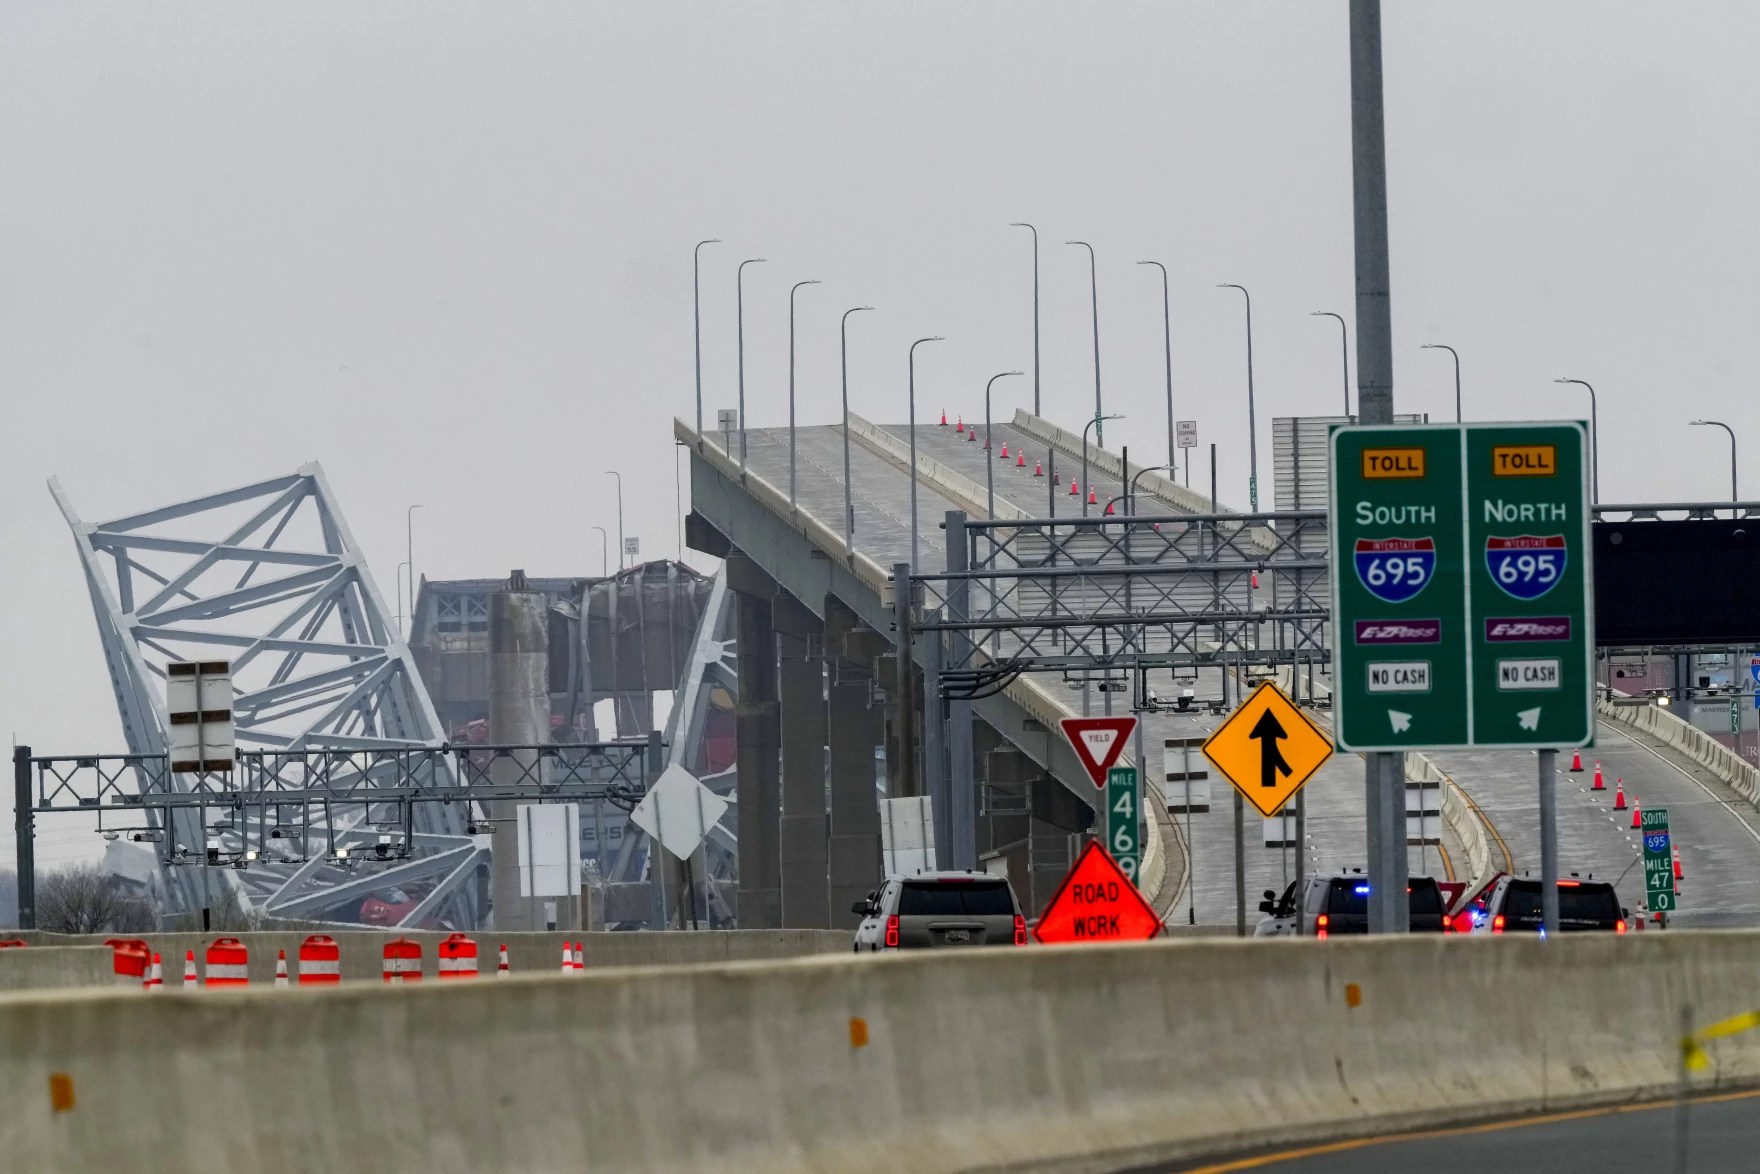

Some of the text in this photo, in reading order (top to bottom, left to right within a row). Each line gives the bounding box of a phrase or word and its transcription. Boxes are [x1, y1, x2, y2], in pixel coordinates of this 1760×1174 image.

[1369, 456, 1419, 471] TOLL
[1499, 453, 1549, 469] TOLL
[1372, 542, 1416, 551] INTERSTATE
[1503, 540, 1547, 549] INTERSTATE
[1367, 557, 1426, 586] 695
[1498, 554, 1557, 584] 695
[1372, 669, 1426, 685] NO CASH
[1502, 666, 1556, 682] NO CASH
[1088, 734, 1110, 742] YIELD
[1111, 773, 1134, 786] MILE
[1641, 812, 1668, 825] SOUTH
[1648, 836, 1666, 848] 695
[1646, 858, 1671, 871] MILE
[1650, 872, 1669, 888] 47
[1073, 882, 1119, 904] ROAD
[1655, 894, 1669, 910] .0
[1074, 915, 1120, 937] WORK
